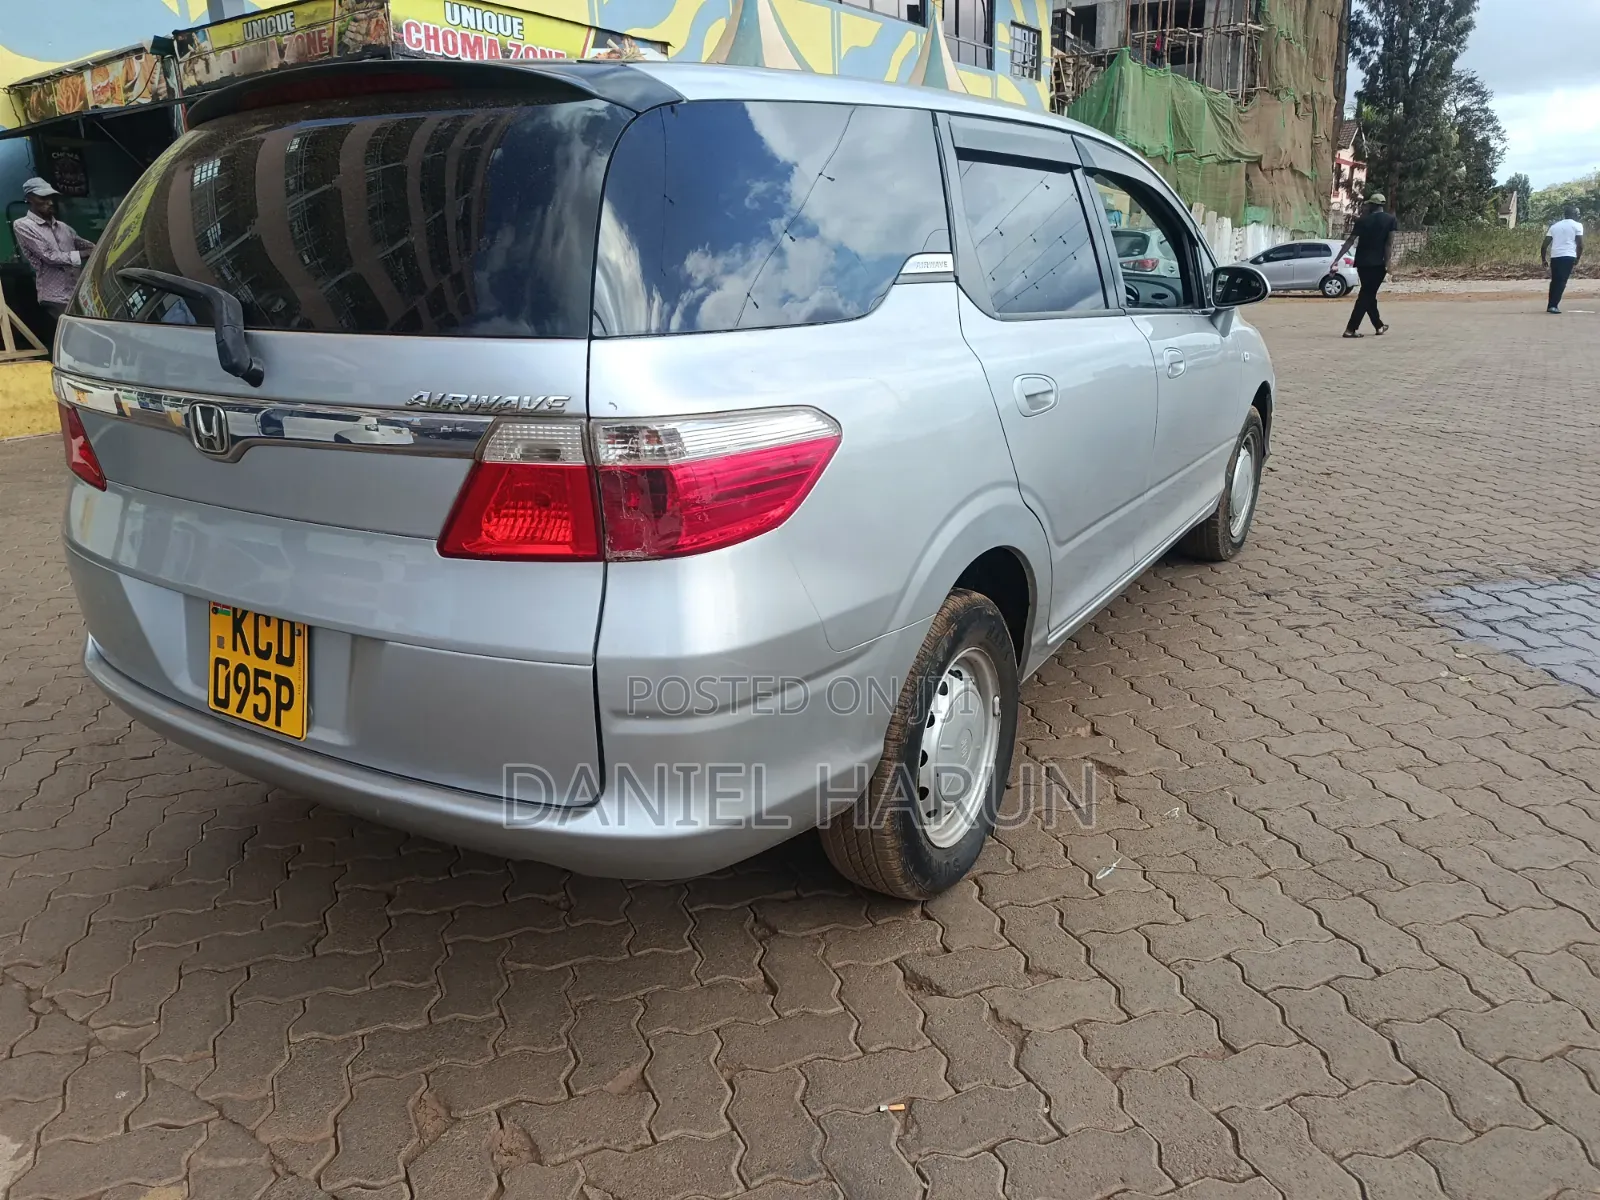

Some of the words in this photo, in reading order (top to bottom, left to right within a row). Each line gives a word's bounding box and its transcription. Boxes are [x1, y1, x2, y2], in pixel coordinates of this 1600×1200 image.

[243, 10, 295, 41] UNIQUE
[403, 19, 502, 60] CHOMA
[444, 1, 524, 40] UNIQUE
[282, 27, 329, 64] ZONE
[916, 261, 948, 269] AIRWAVE
[405, 390, 571, 414] AIRWAVE
[231, 607, 295, 667] KCD
[213, 657, 295, 727] 095P
